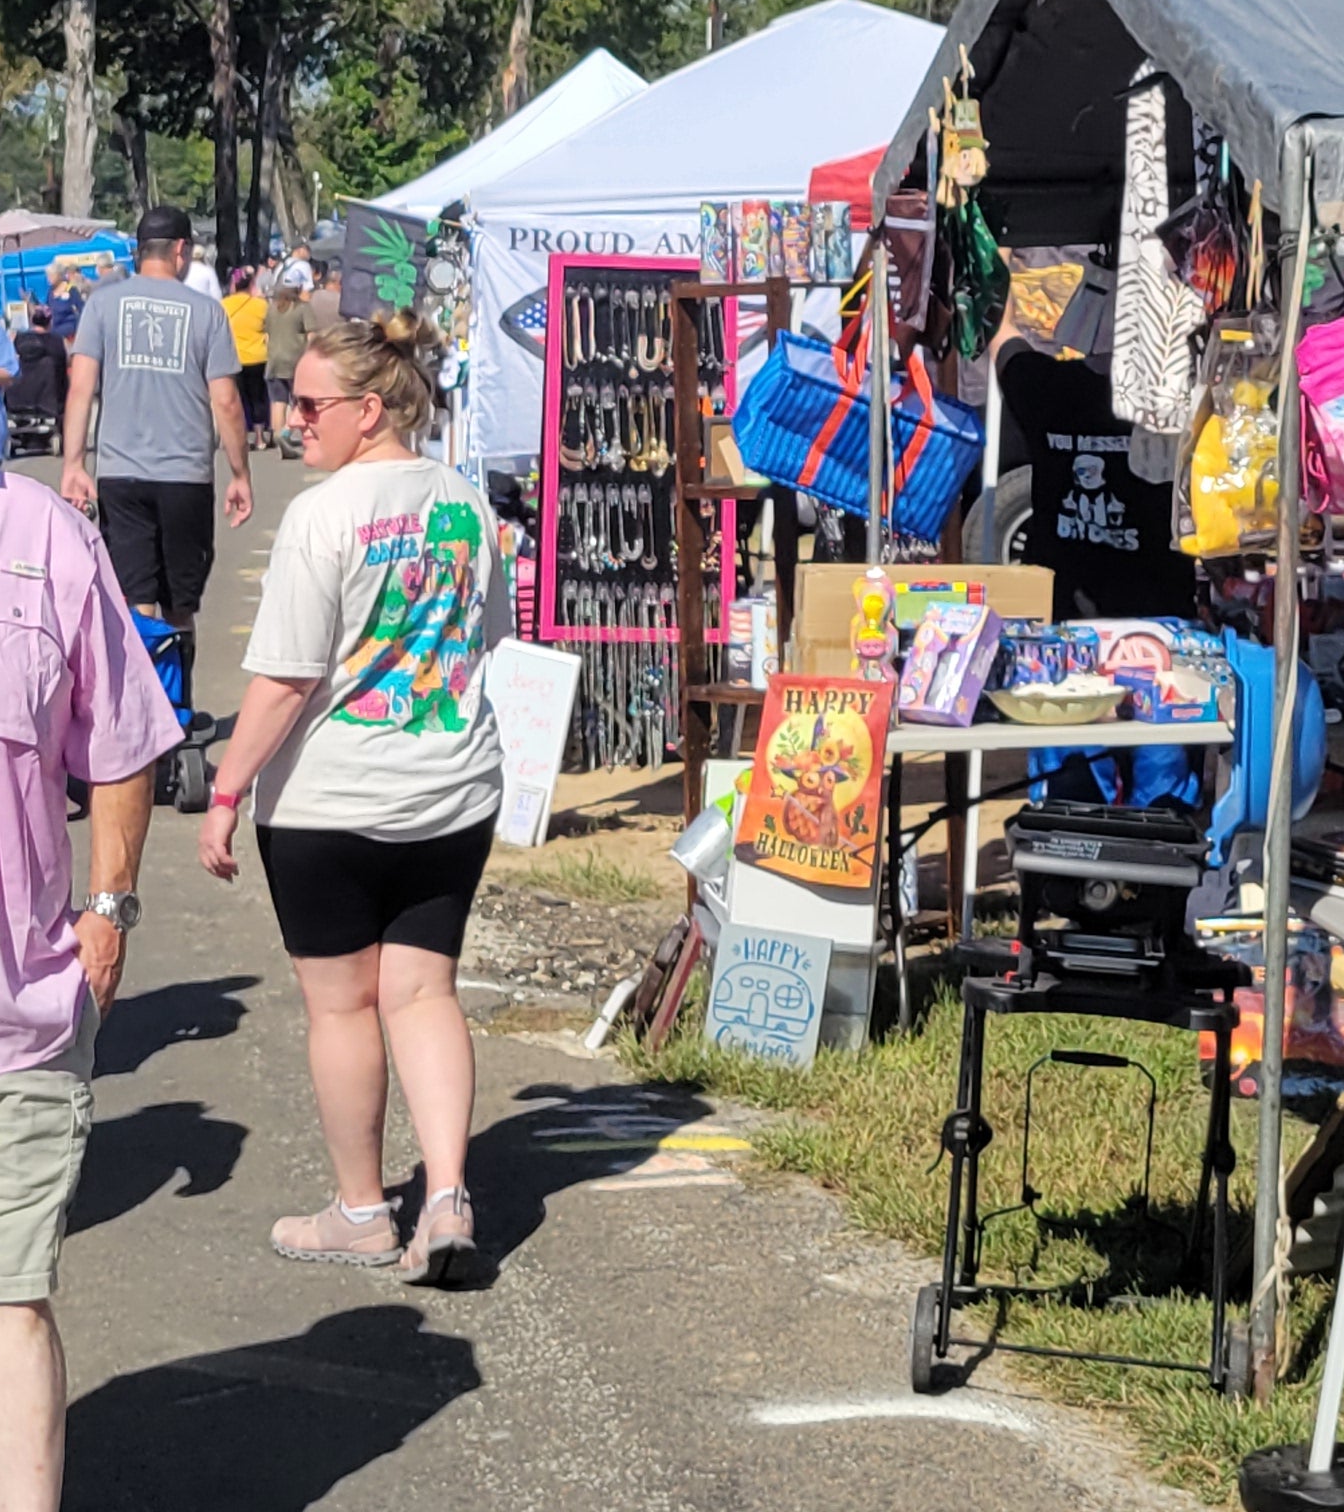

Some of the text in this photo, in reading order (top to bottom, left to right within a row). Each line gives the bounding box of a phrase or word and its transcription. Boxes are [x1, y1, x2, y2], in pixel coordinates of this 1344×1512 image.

[508, 226, 636, 255] PROUD
[1047, 433, 1073, 451] YOU
[784, 686, 875, 716] HAPPY
[756, 831, 851, 873] HALLOWEEN
[743, 936, 807, 970] HAPPY
